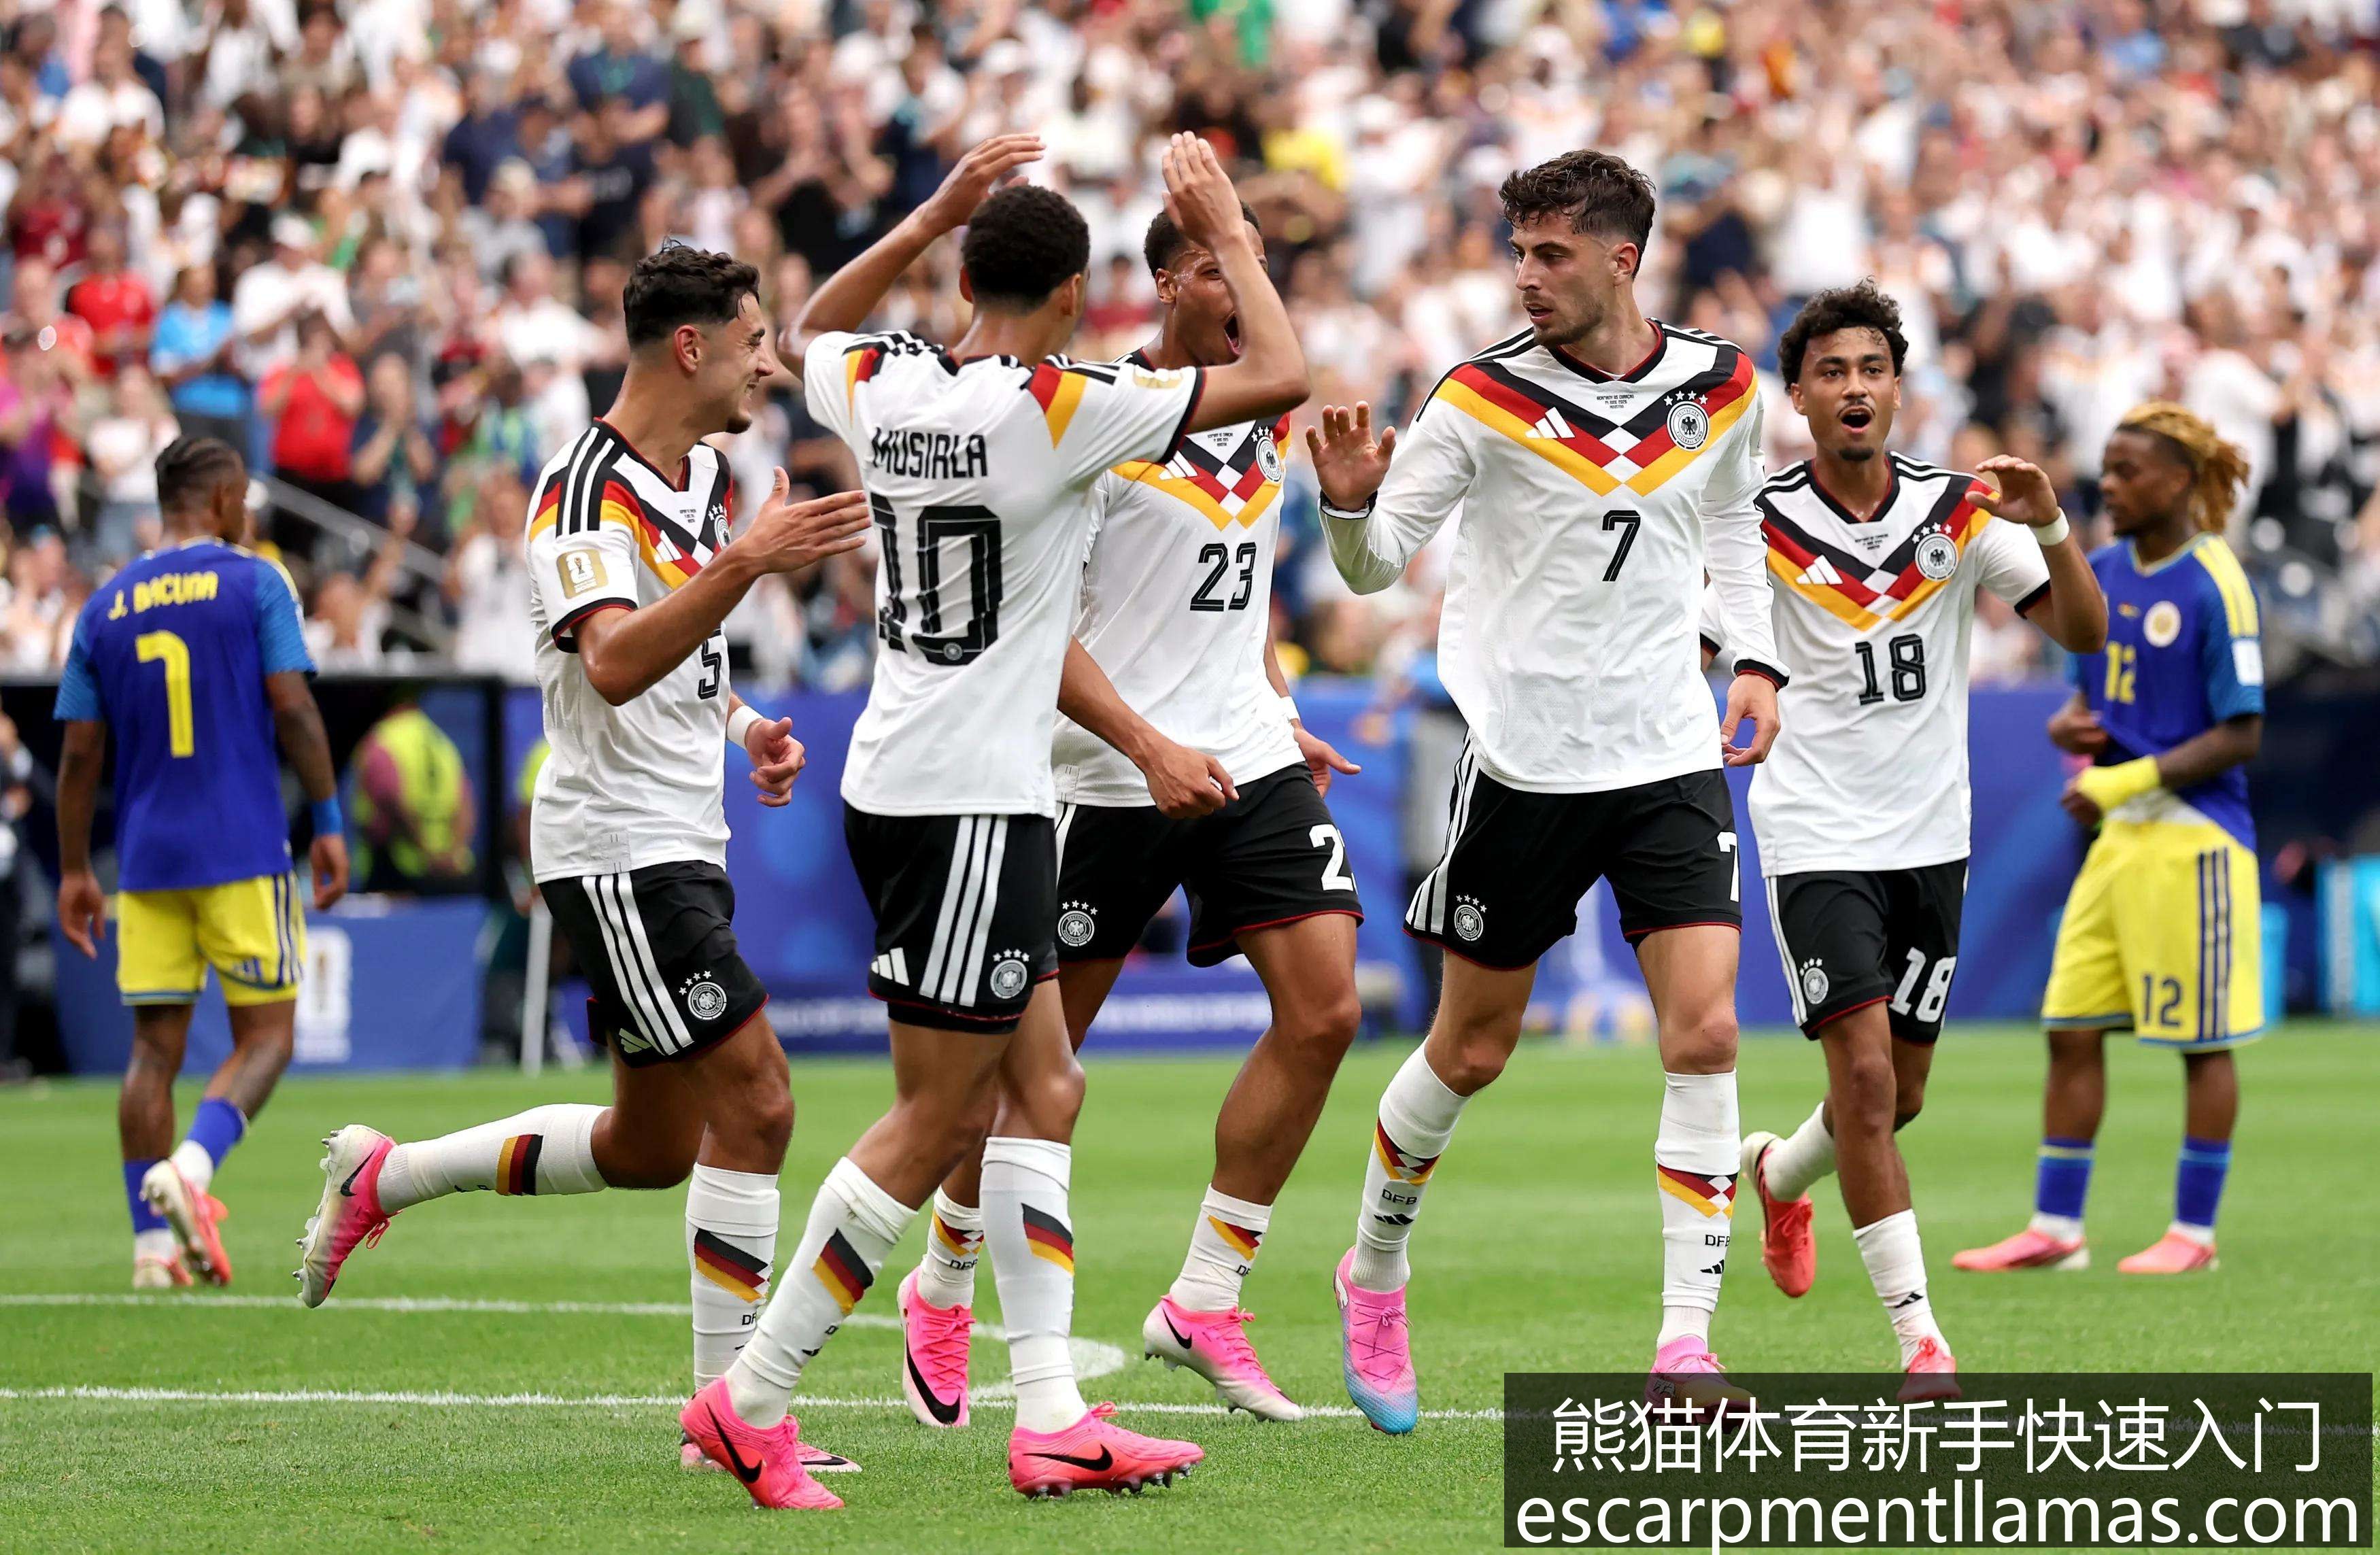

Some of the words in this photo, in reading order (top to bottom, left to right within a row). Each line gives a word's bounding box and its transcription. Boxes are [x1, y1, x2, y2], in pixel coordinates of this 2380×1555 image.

[871, 427, 987, 479] MUSIALA
[871, 492, 1003, 666] 10
[1190, 542, 1257, 611] 23
[1603, 510, 1641, 582] 7
[135, 629, 195, 759] 7
[698, 623, 722, 700] 5
[1855, 634, 1926, 706] 18
[2104, 640, 2138, 705] 12
[1309, 824, 1359, 895] 2
[1717, 832, 1739, 902] 7
[1888, 946, 1957, 1023] 18
[2143, 973, 2183, 1026] 12
[1382, 1189, 1418, 1205] DFB
